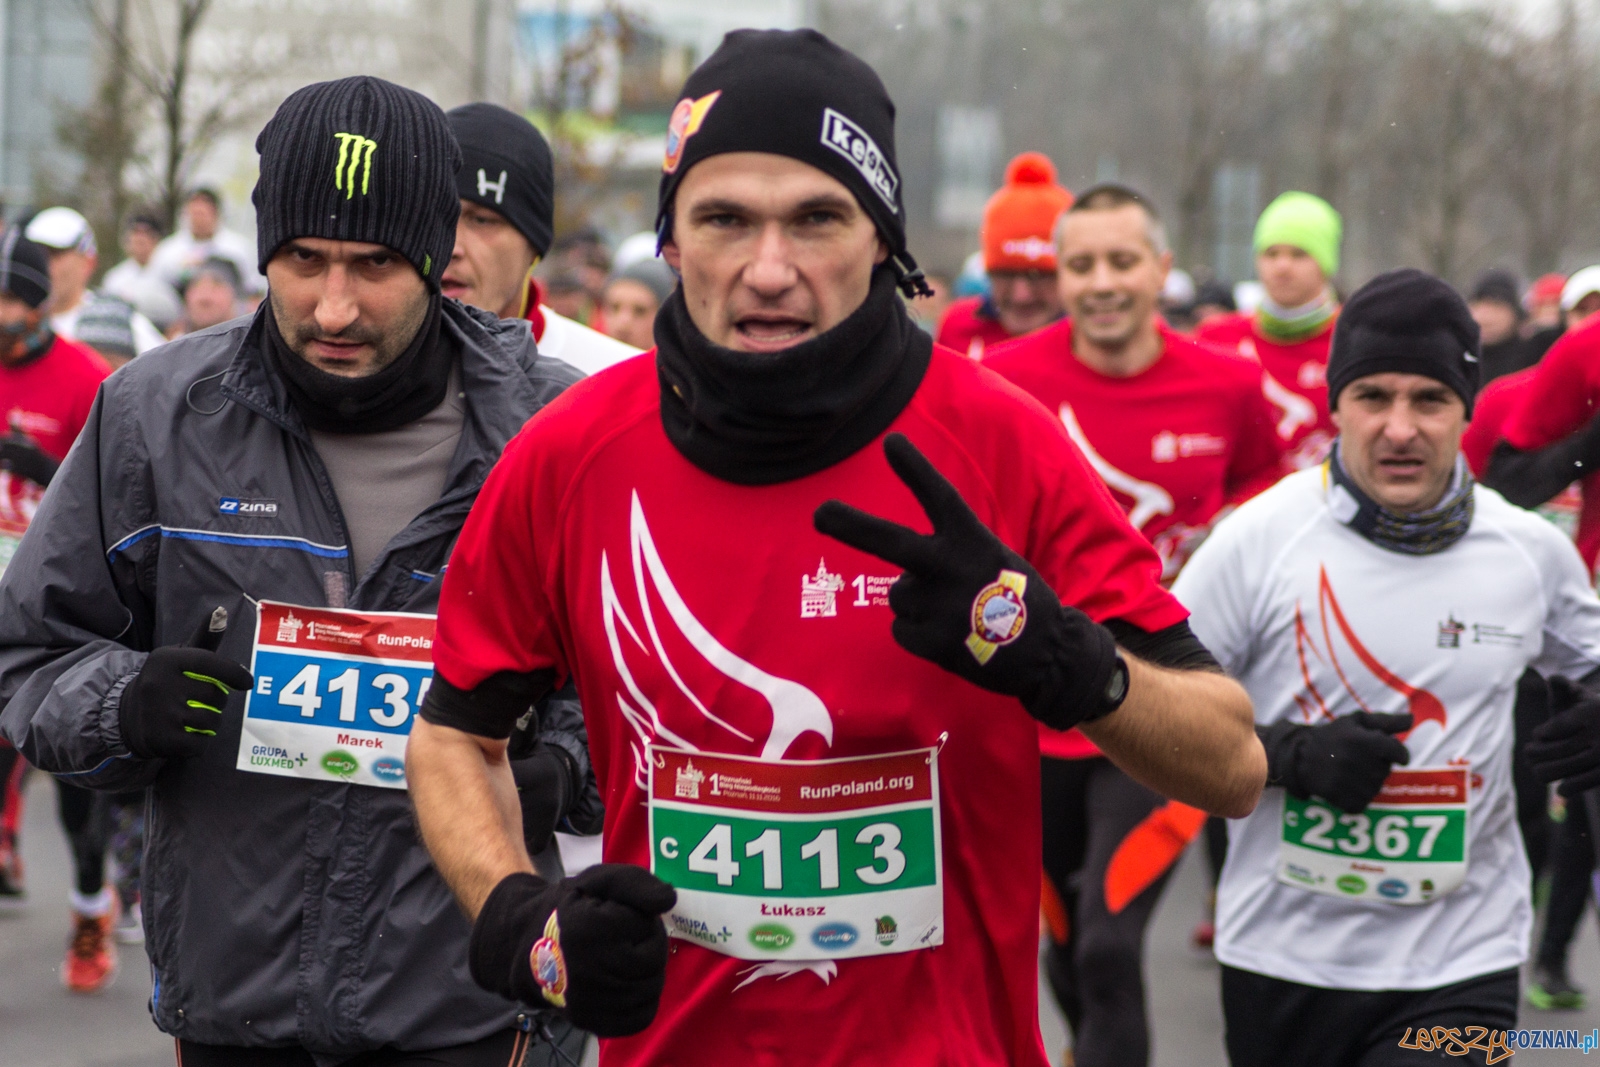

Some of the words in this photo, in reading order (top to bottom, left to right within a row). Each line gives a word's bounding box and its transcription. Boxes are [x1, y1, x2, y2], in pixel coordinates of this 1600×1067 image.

[851, 574, 870, 606] 1
[867, 584, 888, 596] Bieg
[306, 621, 316, 640] 1
[257, 675, 273, 695] E
[337, 733, 383, 749] Marek
[252, 745, 288, 758] GRUPA
[250, 755, 294, 769] LUXMED
[709, 773, 721, 796] 1
[719, 774, 752, 785] Poznański
[719, 781, 734, 791] Bieg
[800, 775, 914, 800] RunPoland.org
[1301, 805, 1449, 858] 2367
[660, 837, 679, 859] C
[688, 822, 907, 889] 4113
[760, 903, 826, 917] Łukasz
